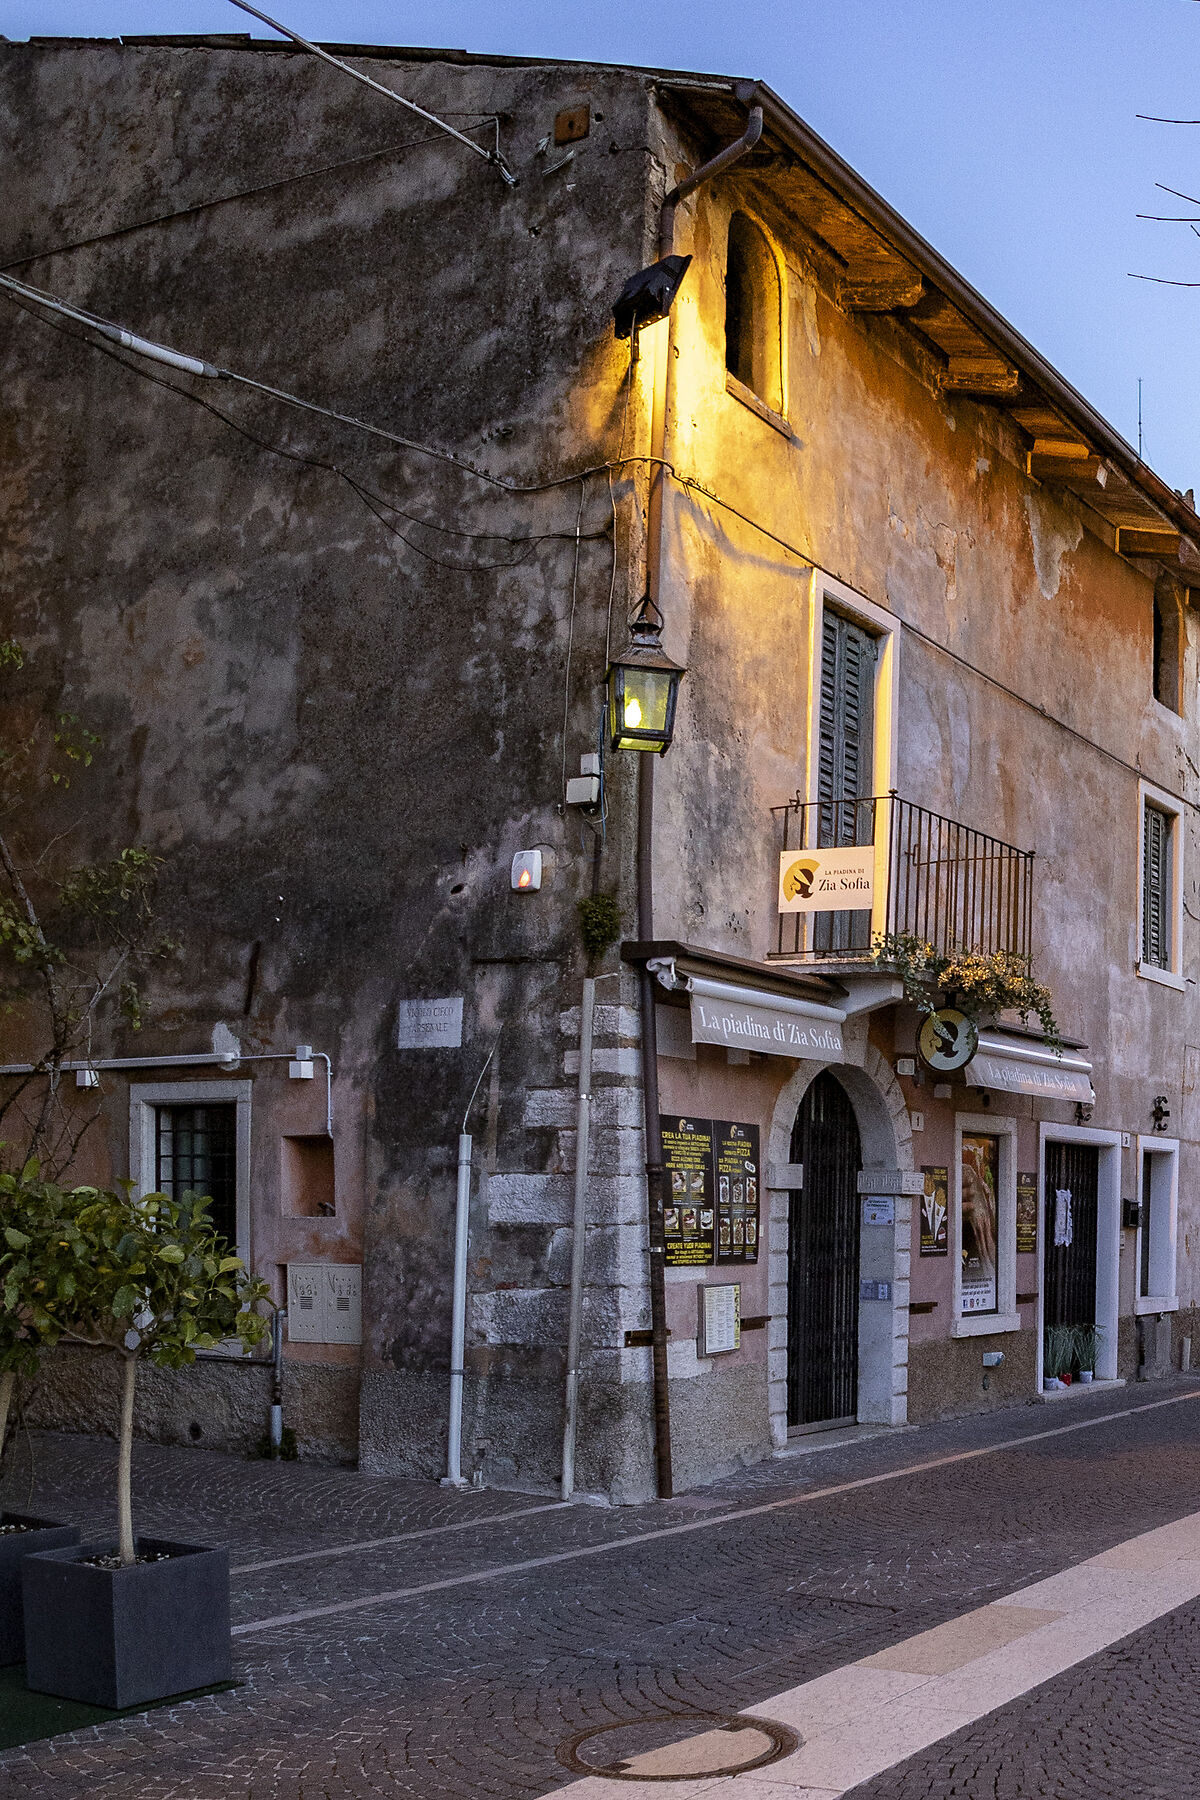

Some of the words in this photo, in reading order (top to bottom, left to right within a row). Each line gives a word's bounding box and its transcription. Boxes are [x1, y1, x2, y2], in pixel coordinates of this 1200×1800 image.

[818, 879, 836, 891] Zia
[840, 876, 870, 890] Sofia
[407, 1008, 432, 1018] VICOLO
[434, 1006, 454, 1016] CIECO
[698, 1006, 720, 1030] La
[722, 1013, 770, 1039] piadina
[773, 1020, 786, 1042] di
[788, 1023, 808, 1046] Zia
[810, 1028, 842, 1050] Sofia
[986, 1060, 1001, 1079] La
[1002, 1067, 1034, 1085] piadina
[1034, 1070, 1042, 1086] di
[1042, 1072, 1056, 1088] Zia
[1054, 1072, 1077, 1091] Sofia
[662, 1131, 674, 1139] CREA
[736, 1148, 750, 1157] PIZZA
